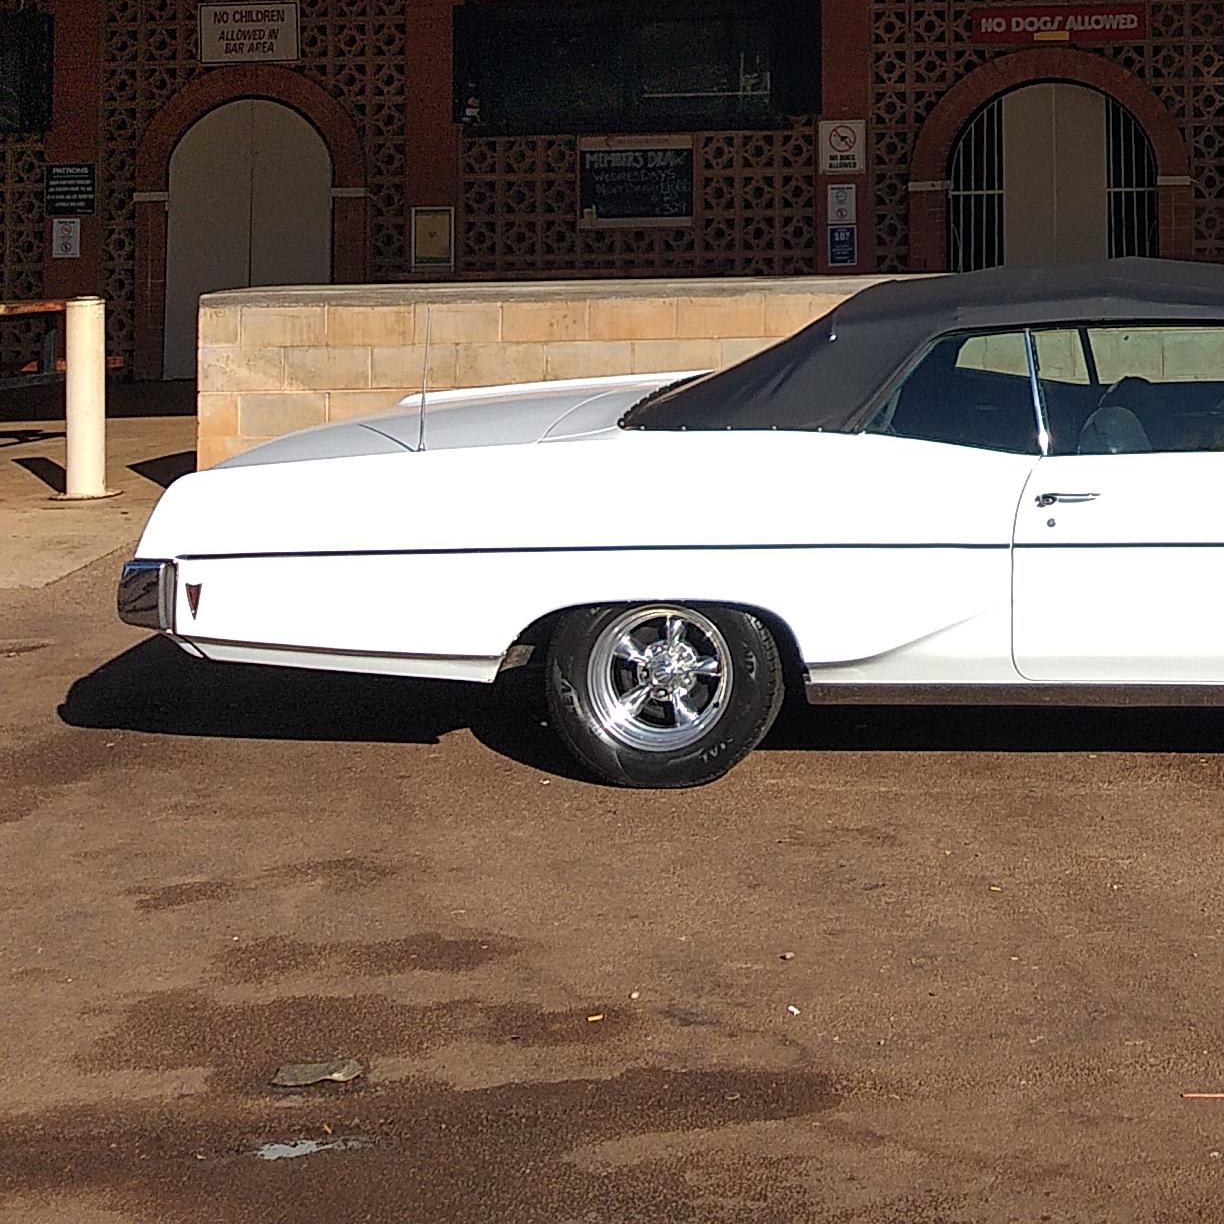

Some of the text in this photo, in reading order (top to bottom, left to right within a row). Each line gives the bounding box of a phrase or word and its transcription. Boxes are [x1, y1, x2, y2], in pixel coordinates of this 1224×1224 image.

[213, 9, 285, 24] NO CHILDREN
[980, 13, 1138, 33] NO DOGS ALLOWED
[218, 28, 280, 41] ALLOWED IN
[224, 41, 274, 54] BAR AREA
[585, 151, 645, 169] MEMBERS
